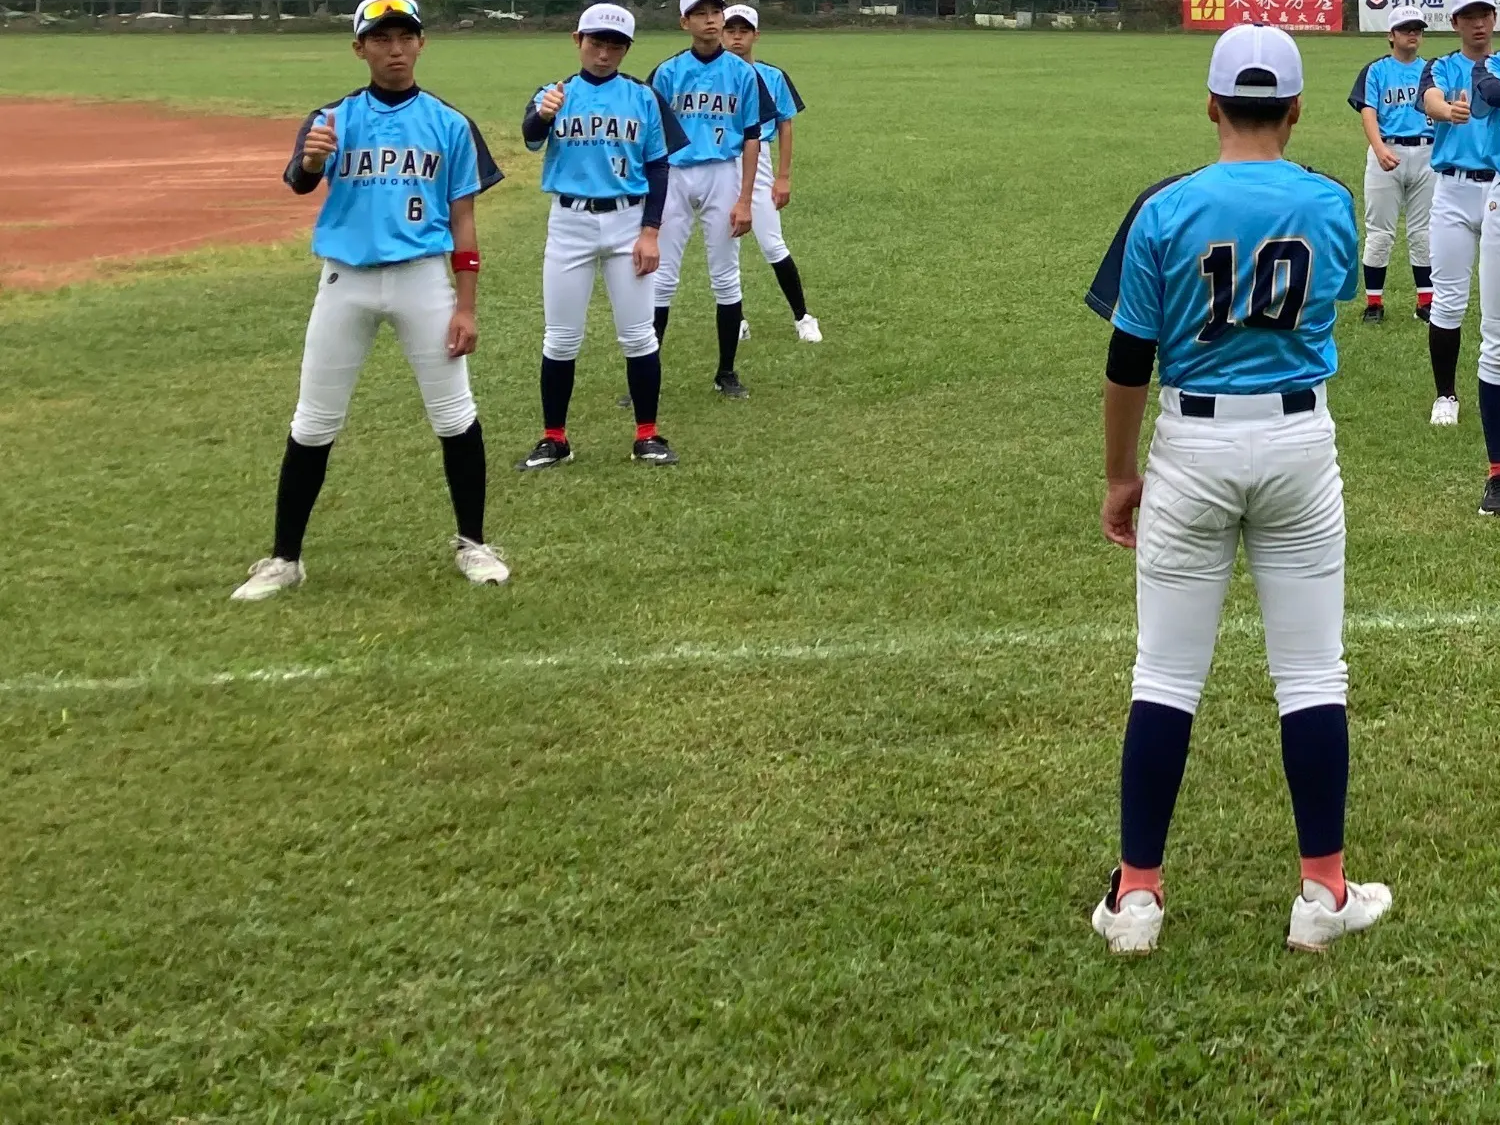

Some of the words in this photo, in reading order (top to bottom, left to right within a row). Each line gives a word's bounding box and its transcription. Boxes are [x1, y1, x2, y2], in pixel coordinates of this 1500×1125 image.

[599, 14, 626, 23] JAPAN
[1384, 87, 1417, 104] JAP
[554, 114, 640, 143] JAPAN
[714, 126, 725, 146] 7
[337, 147, 441, 180] JAPAN
[352, 176, 420, 188] FUKUOKA
[405, 196, 424, 223] 6
[1195, 237, 1313, 344] 10
